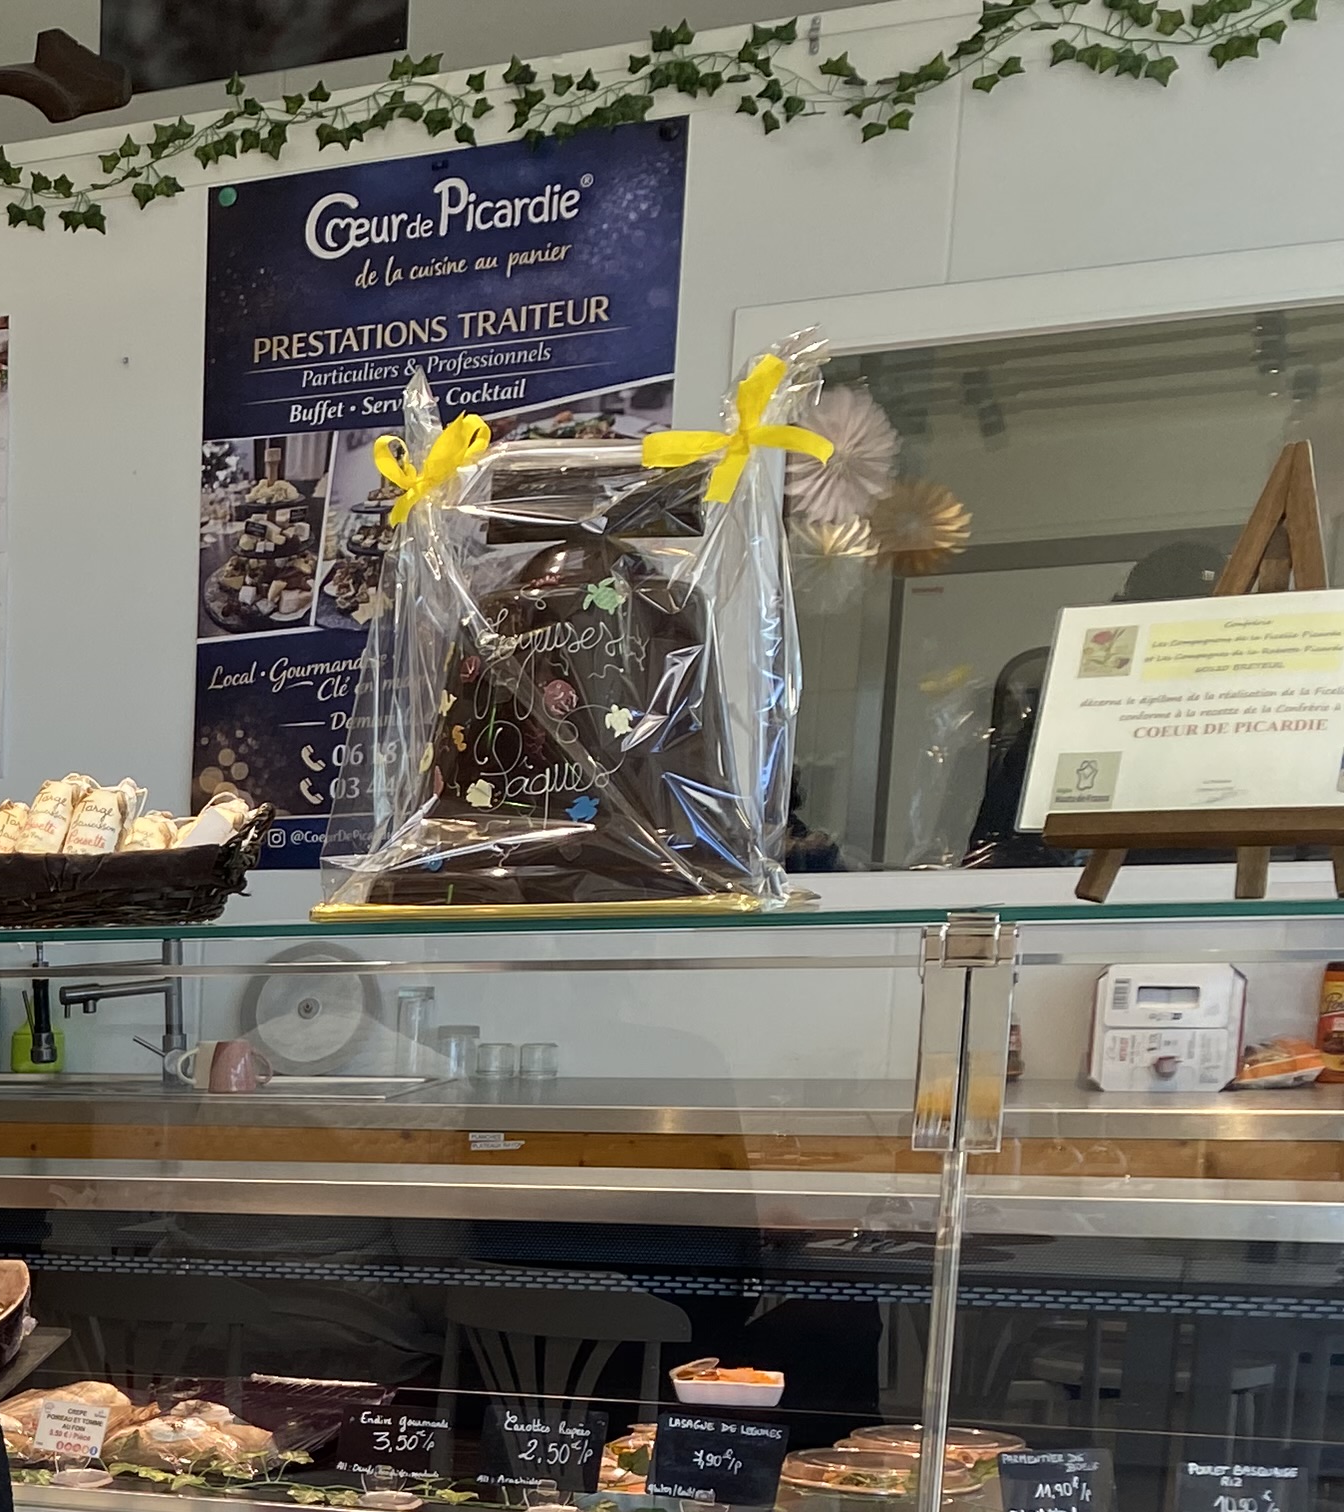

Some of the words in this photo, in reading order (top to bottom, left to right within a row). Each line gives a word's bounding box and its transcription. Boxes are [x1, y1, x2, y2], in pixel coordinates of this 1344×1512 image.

[408, 214, 434, 239] de
[355, 257, 379, 290] de
[384, 255, 404, 288] la
[409, 252, 468, 282] cuisine
[474, 251, 499, 271] au
[506, 241, 573, 279] panier
[252, 315, 449, 365] PRESTATIONS
[457, 294, 611, 341] TRAITEUR
[301, 362, 400, 388] Particuliers
[426, 341, 552, 378] Professionnels
[289, 398, 345, 426] Buffet
[445, 377, 527, 407] Cocktail
[207, 661, 257, 692] Local
[316, 674, 350, 702] Clé
[1132, 720, 1199, 740] COEUR
[1203, 719, 1229, 736] DE
[1233, 718, 1329, 735] PICARDIE
[331, 742, 365, 768] 06
[329, 777, 361, 801] 03
[668, 1416, 715, 1431] LASAGNE
[720, 1422, 738, 1433] DE
[1001, 1452, 1064, 1465] PARMENTIER
[1187, 1462, 1232, 1476] POULET
